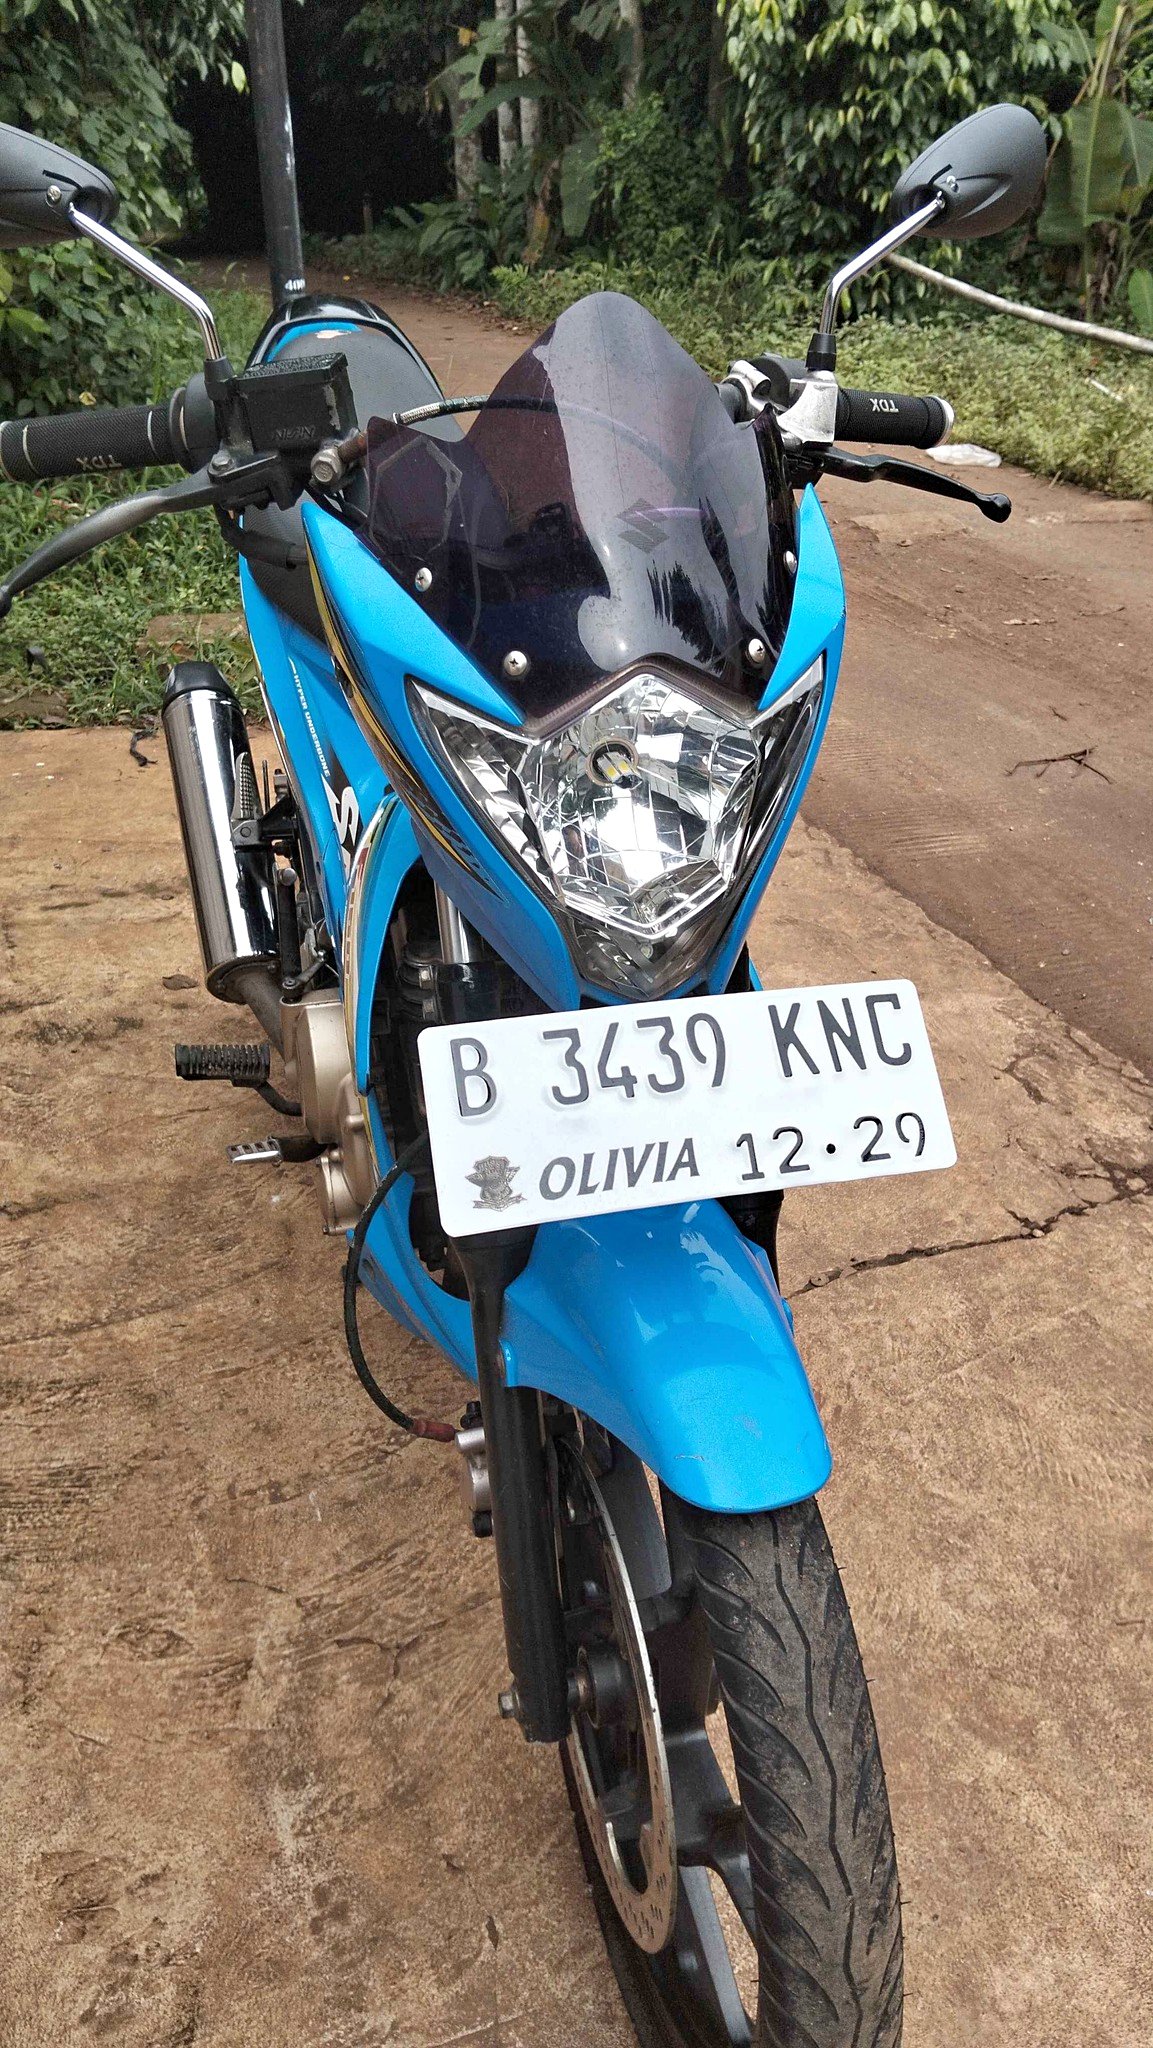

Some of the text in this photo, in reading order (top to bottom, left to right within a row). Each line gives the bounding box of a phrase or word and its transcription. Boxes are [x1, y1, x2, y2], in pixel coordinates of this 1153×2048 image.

[870, 398, 899, 412] TDX
[76, 455, 122, 471] TDX
[294, 675, 331, 777] HYPER UNDERBONE
[449, 993, 912, 1117] B 3439 KNC
[538, 1137, 700, 1200] OLIVIA
